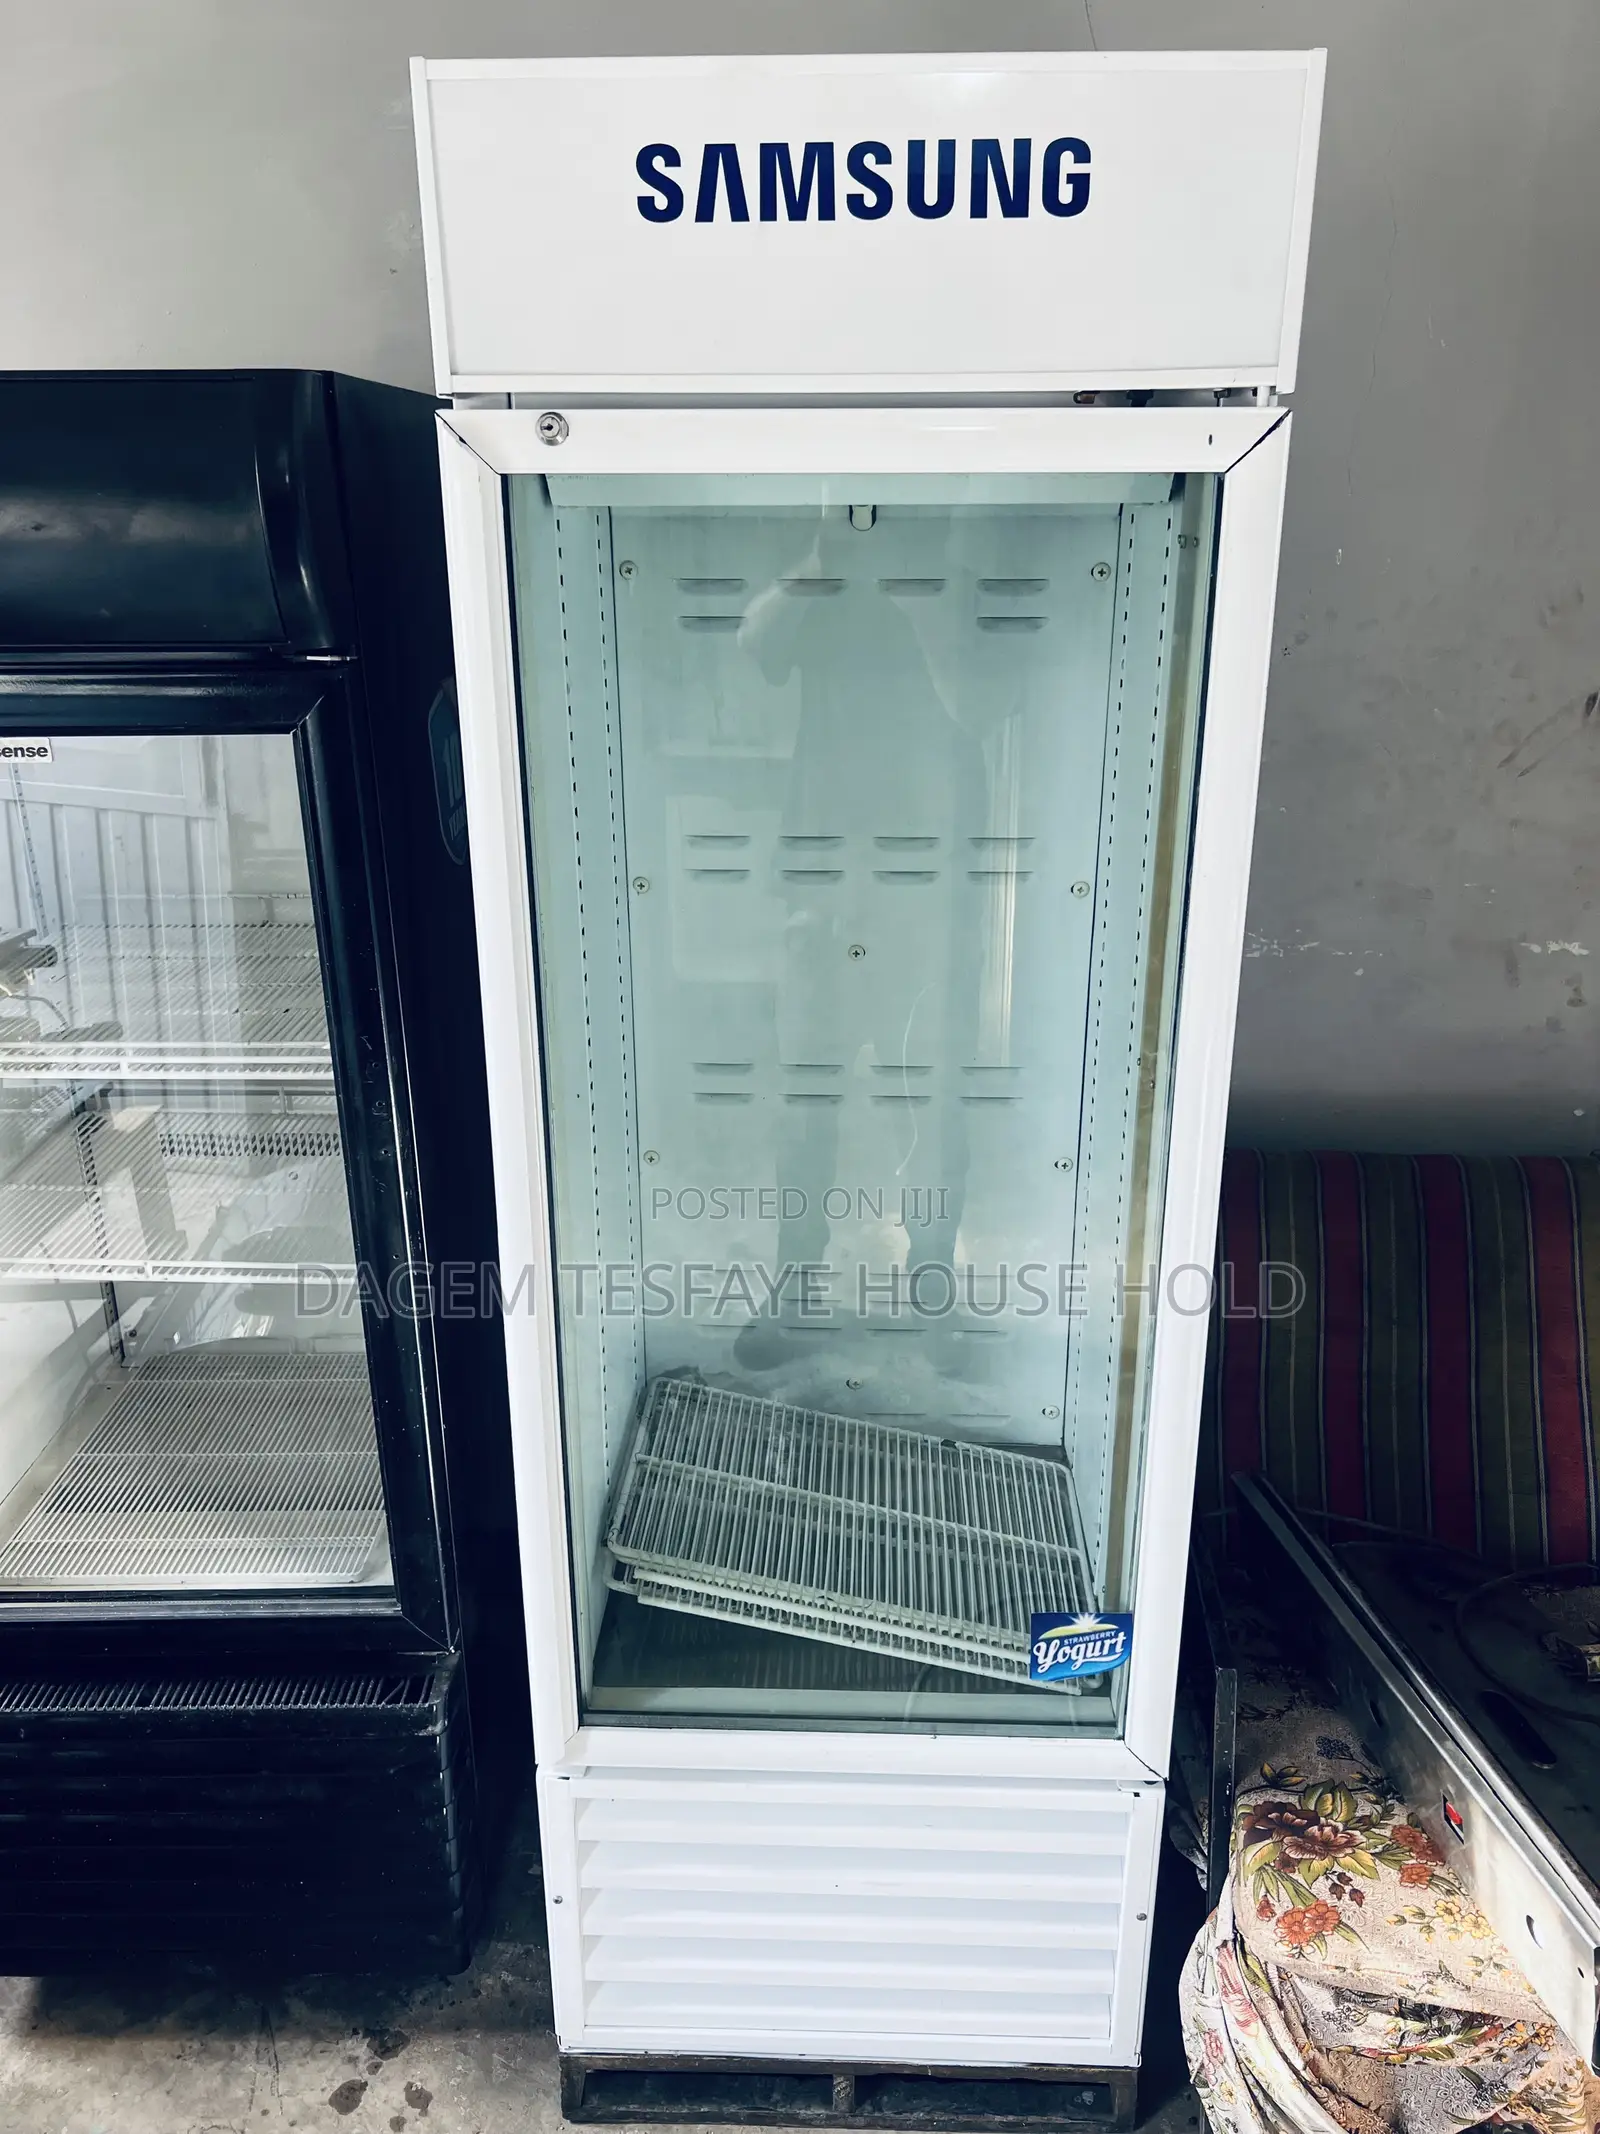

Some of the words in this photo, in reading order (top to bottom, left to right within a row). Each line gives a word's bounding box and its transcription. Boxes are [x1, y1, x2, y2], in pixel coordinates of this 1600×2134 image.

[635, 137, 1092, 223] SAMSUNG
[0, 746, 48, 758] ense
[1032, 1631, 1127, 1674] Yogurt
[1063, 1630, 1117, 1646] STRAWBERRY
